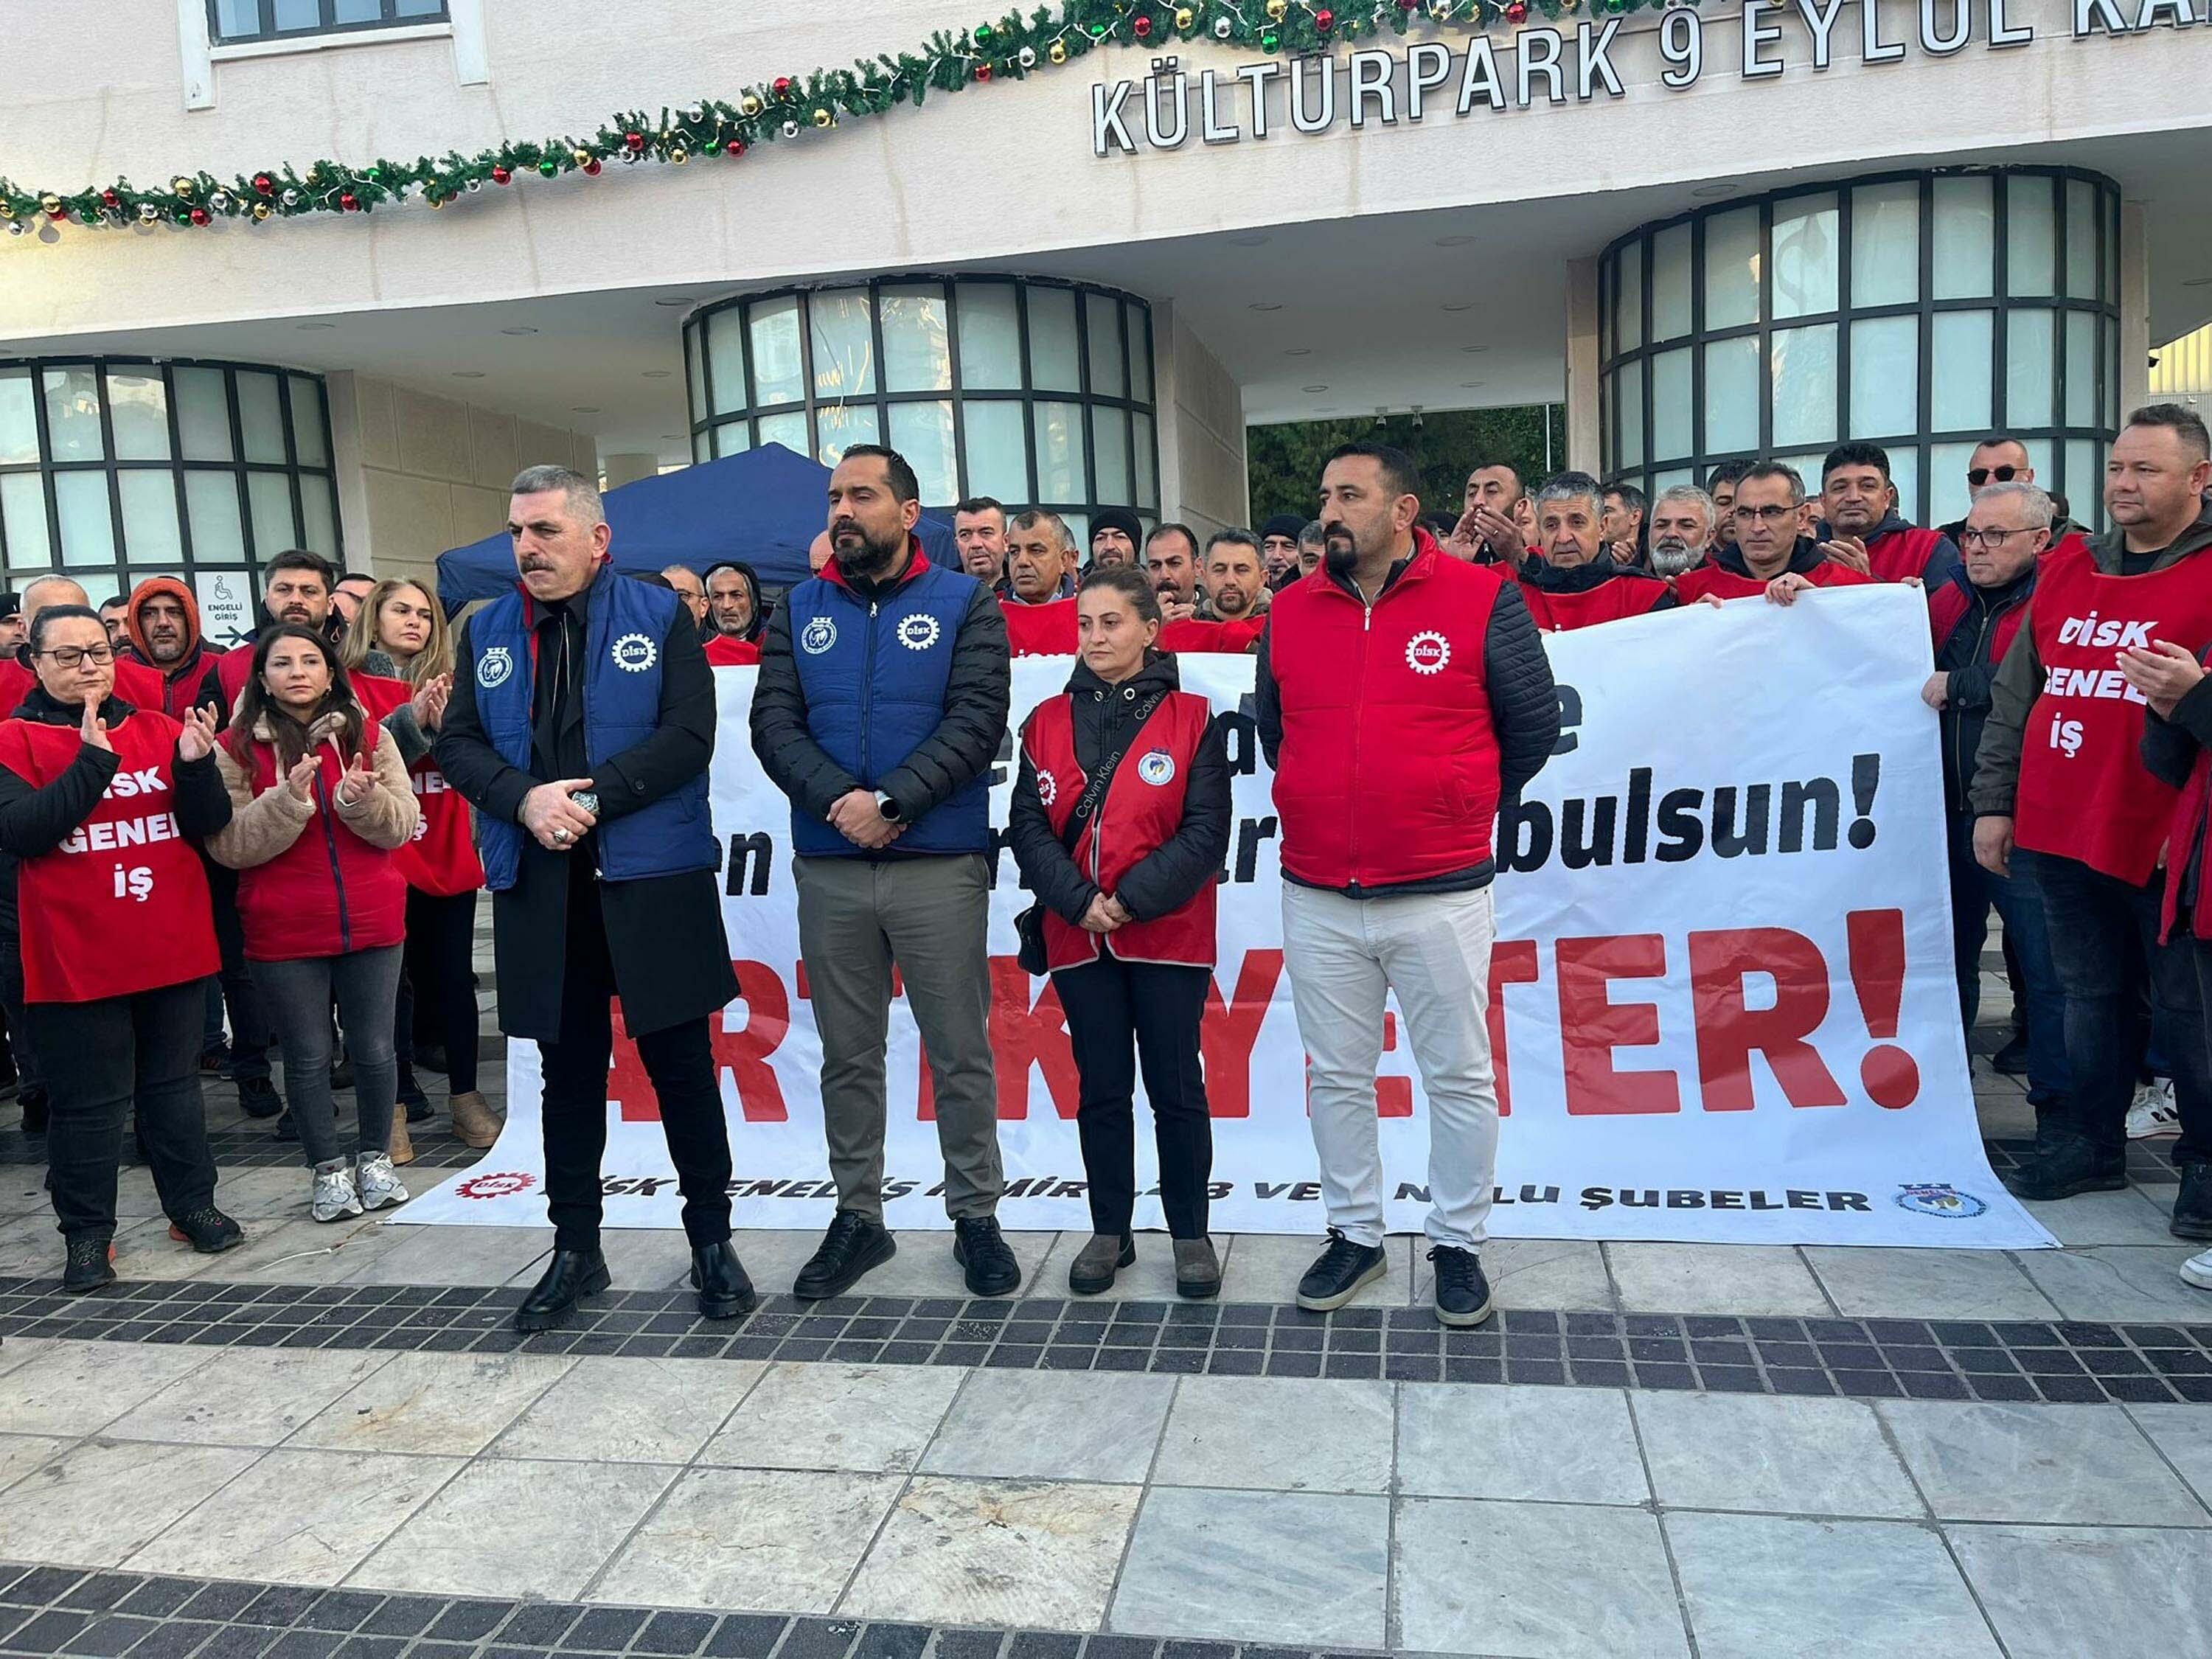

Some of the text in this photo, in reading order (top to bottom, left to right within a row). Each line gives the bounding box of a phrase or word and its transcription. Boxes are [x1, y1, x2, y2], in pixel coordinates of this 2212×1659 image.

[1660, 7, 1703, 90] 9
[208, 602, 243, 611] ENGELLİ
[215, 612, 238, 621] GİRİŞ
[2058, 611, 2159, 648] DİSK
[2050, 712, 2084, 758] İŞ
[1076, 751, 1121, 818] Calvin Klein
[1495, 753, 1880, 873] bulsun!
[114, 863, 154, 902] İŞ
[1579, 1186, 1872, 1211] ŞUBELER
